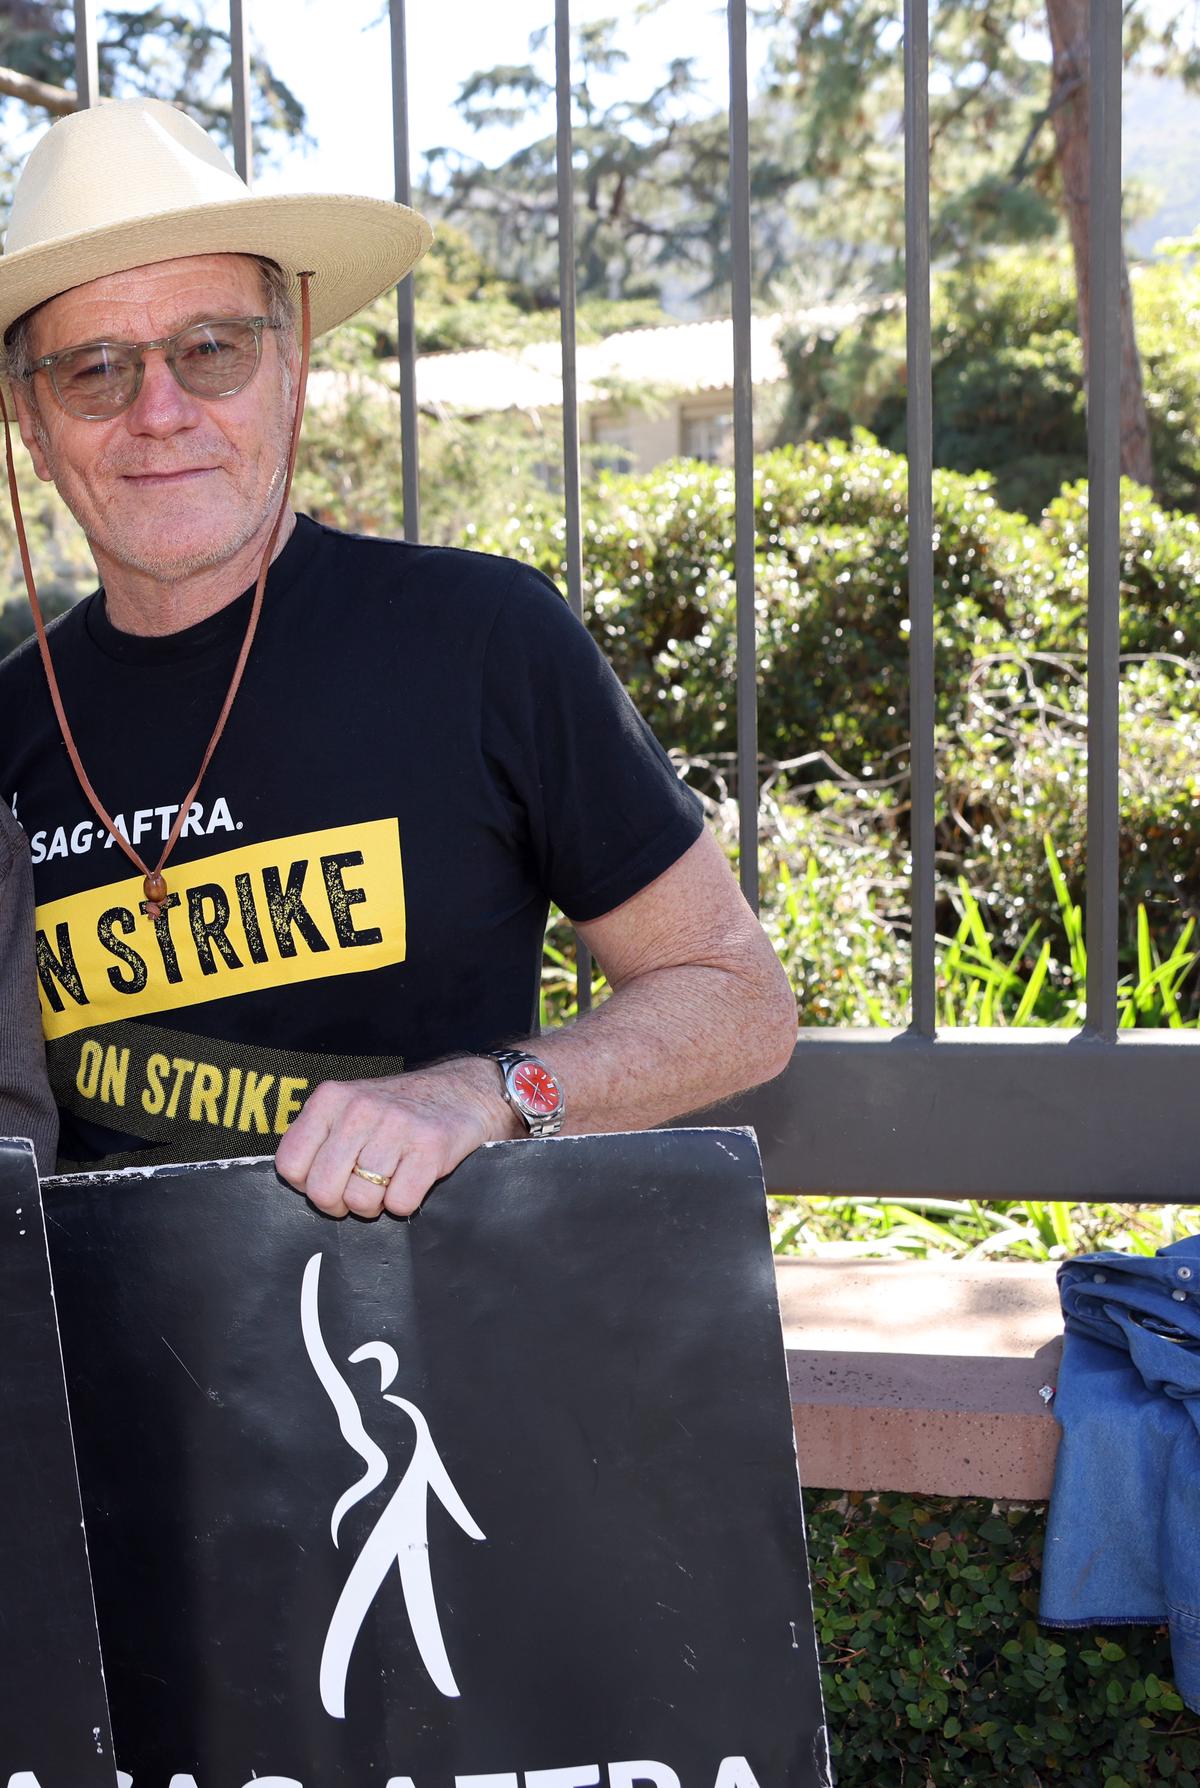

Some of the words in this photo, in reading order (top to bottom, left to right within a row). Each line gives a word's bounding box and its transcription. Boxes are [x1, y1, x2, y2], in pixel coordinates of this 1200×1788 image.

[36, 922, 90, 1013] N
[97, 851, 383, 995] STRIKE
[76, 1040, 130, 1106] ON
[142, 1053, 308, 1134] STRIKE
